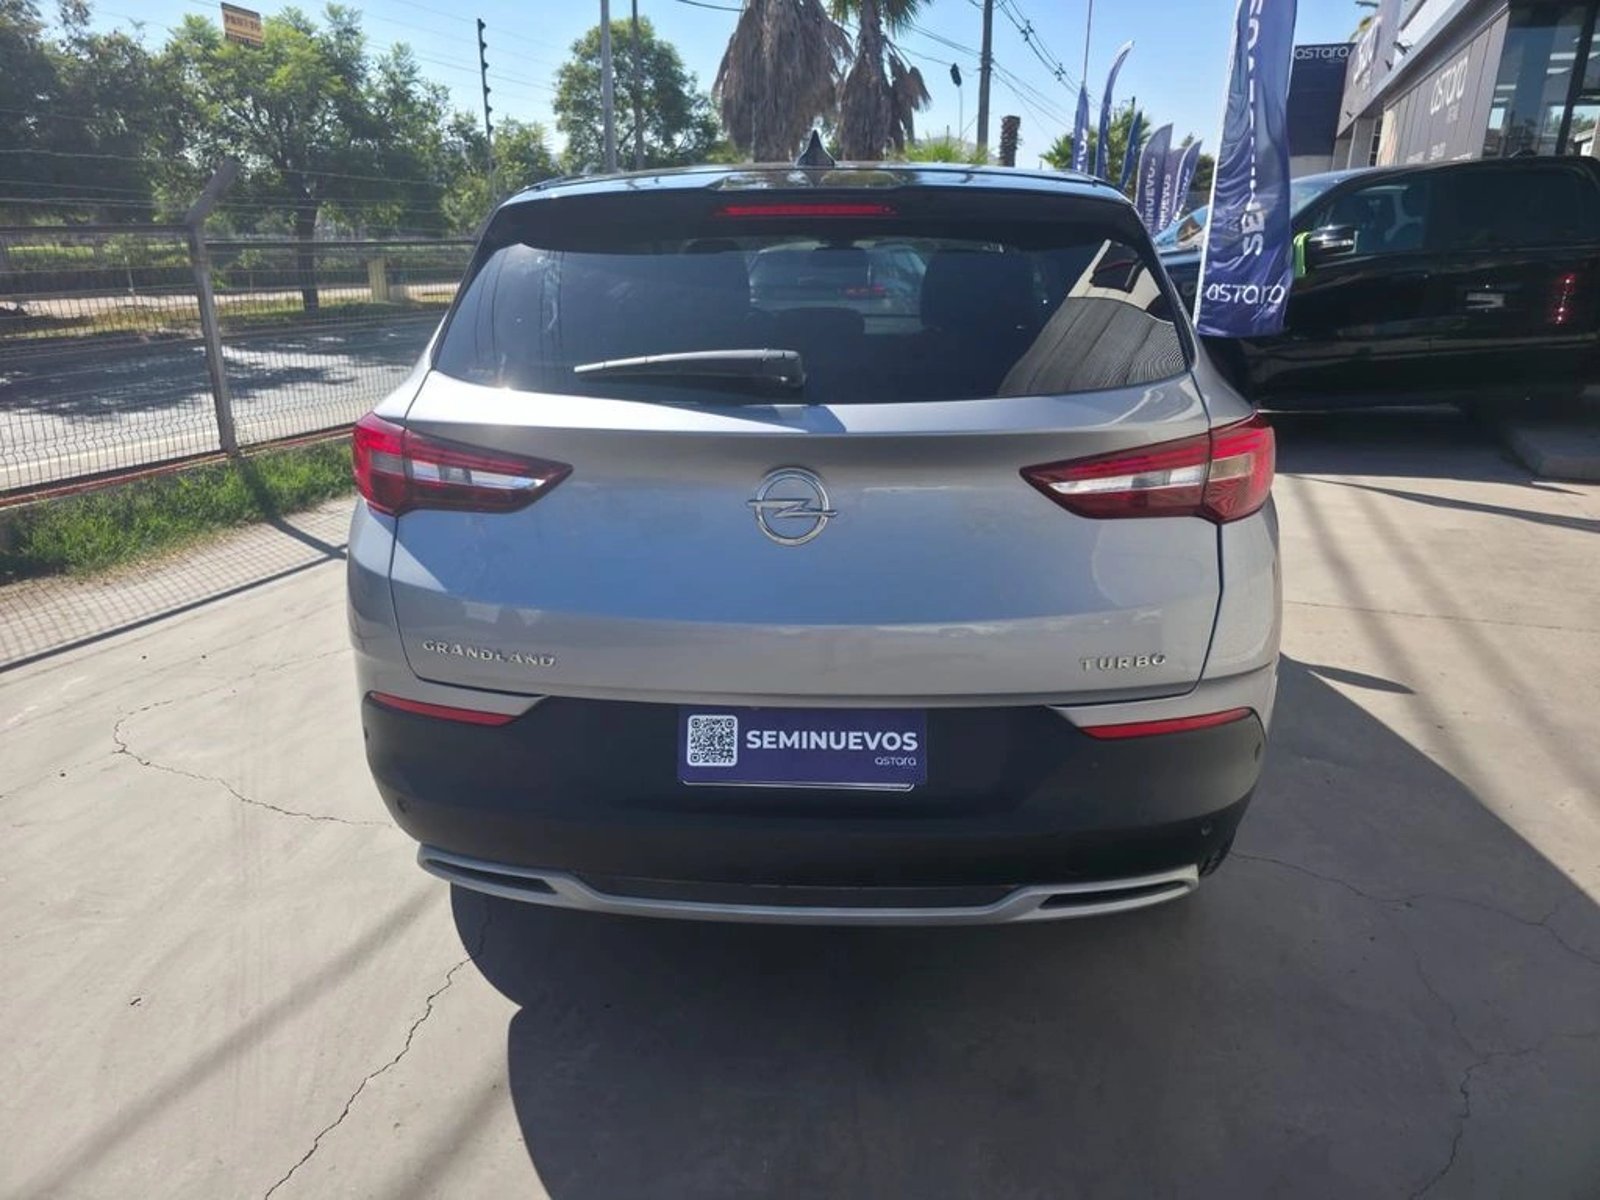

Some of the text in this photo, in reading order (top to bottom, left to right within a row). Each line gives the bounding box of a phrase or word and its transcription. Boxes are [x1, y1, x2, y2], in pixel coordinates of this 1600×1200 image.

[1206, 283, 1285, 305] astara
[422, 640, 555, 667] GRANDLAND
[1079, 653, 1166, 671] TURBO
[746, 730, 918, 751] SEMINUEVOS
[874, 756, 917, 767] astara
